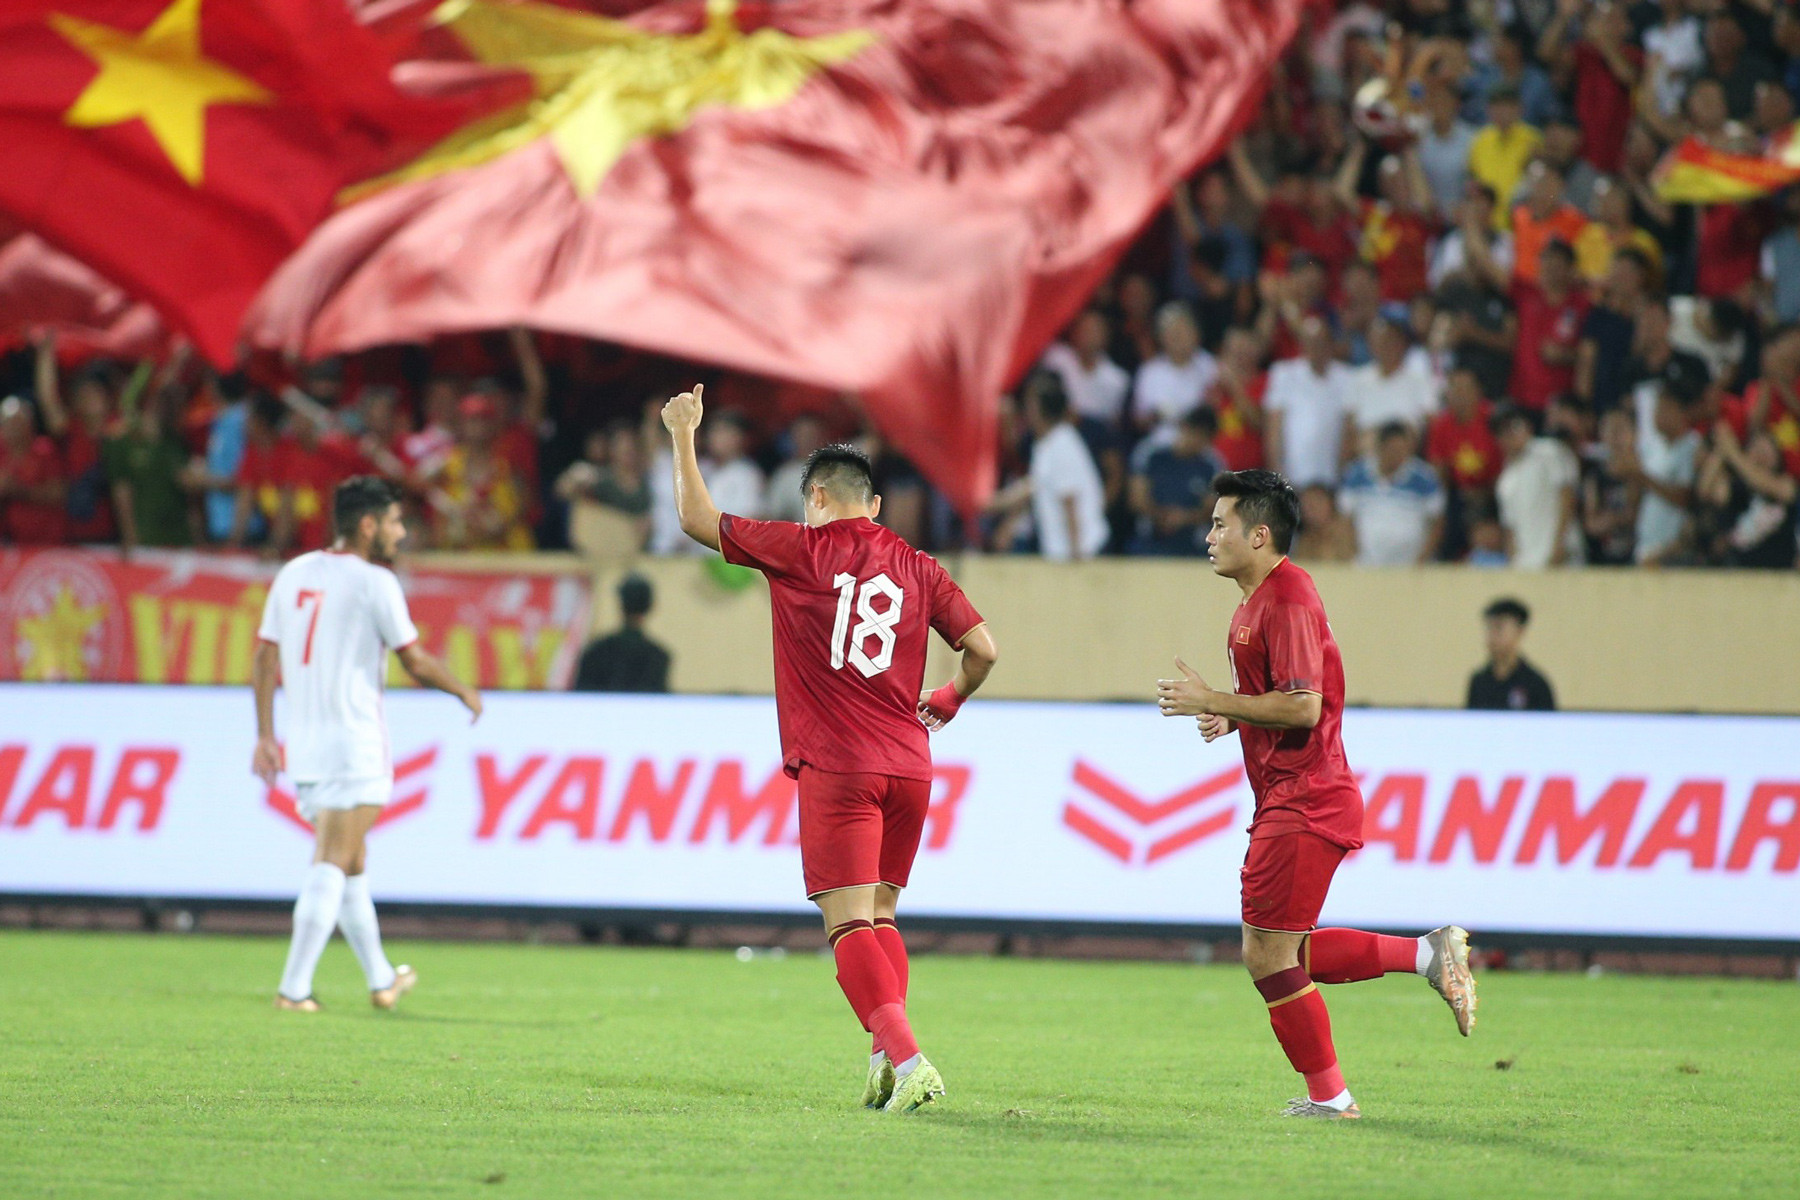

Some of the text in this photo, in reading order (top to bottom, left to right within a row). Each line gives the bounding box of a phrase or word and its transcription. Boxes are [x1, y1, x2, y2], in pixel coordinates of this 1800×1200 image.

[296, 588, 323, 665] 7
[830, 571, 904, 679] 18
[473, 754, 971, 851] YANMR
[1342, 773, 1800, 873] ANMAR
